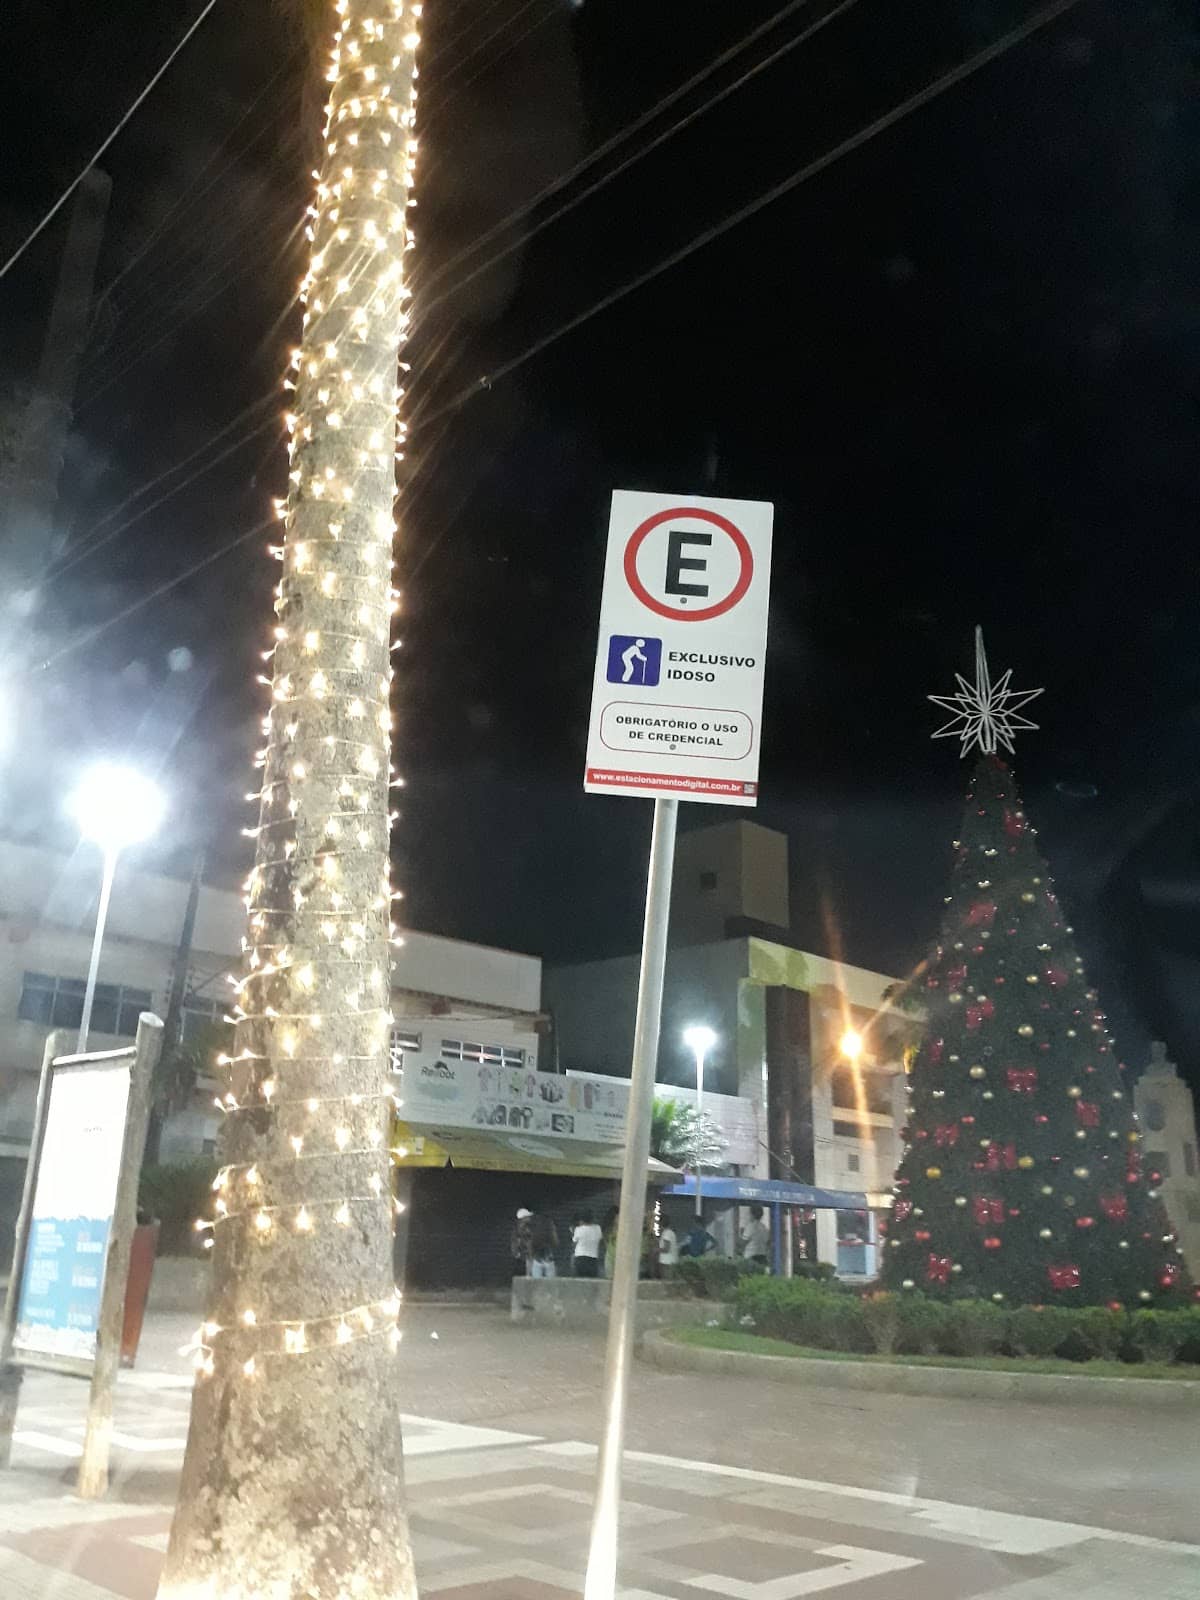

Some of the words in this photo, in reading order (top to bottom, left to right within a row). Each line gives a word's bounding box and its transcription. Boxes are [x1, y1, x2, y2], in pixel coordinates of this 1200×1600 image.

[665, 531, 712, 597] E
[669, 651, 756, 668] EXCLUSIVO
[667, 669, 715, 682] IDOSO
[616, 715, 697, 730] OBRIGATÓRIO
[701, 722, 710, 730] O
[714, 724, 738, 733] USO
[629, 730, 643, 739] DE
[648, 732, 723, 746] CREDENCIAL
[593, 772, 742, 792] www.estacionamentodigital.com.br
